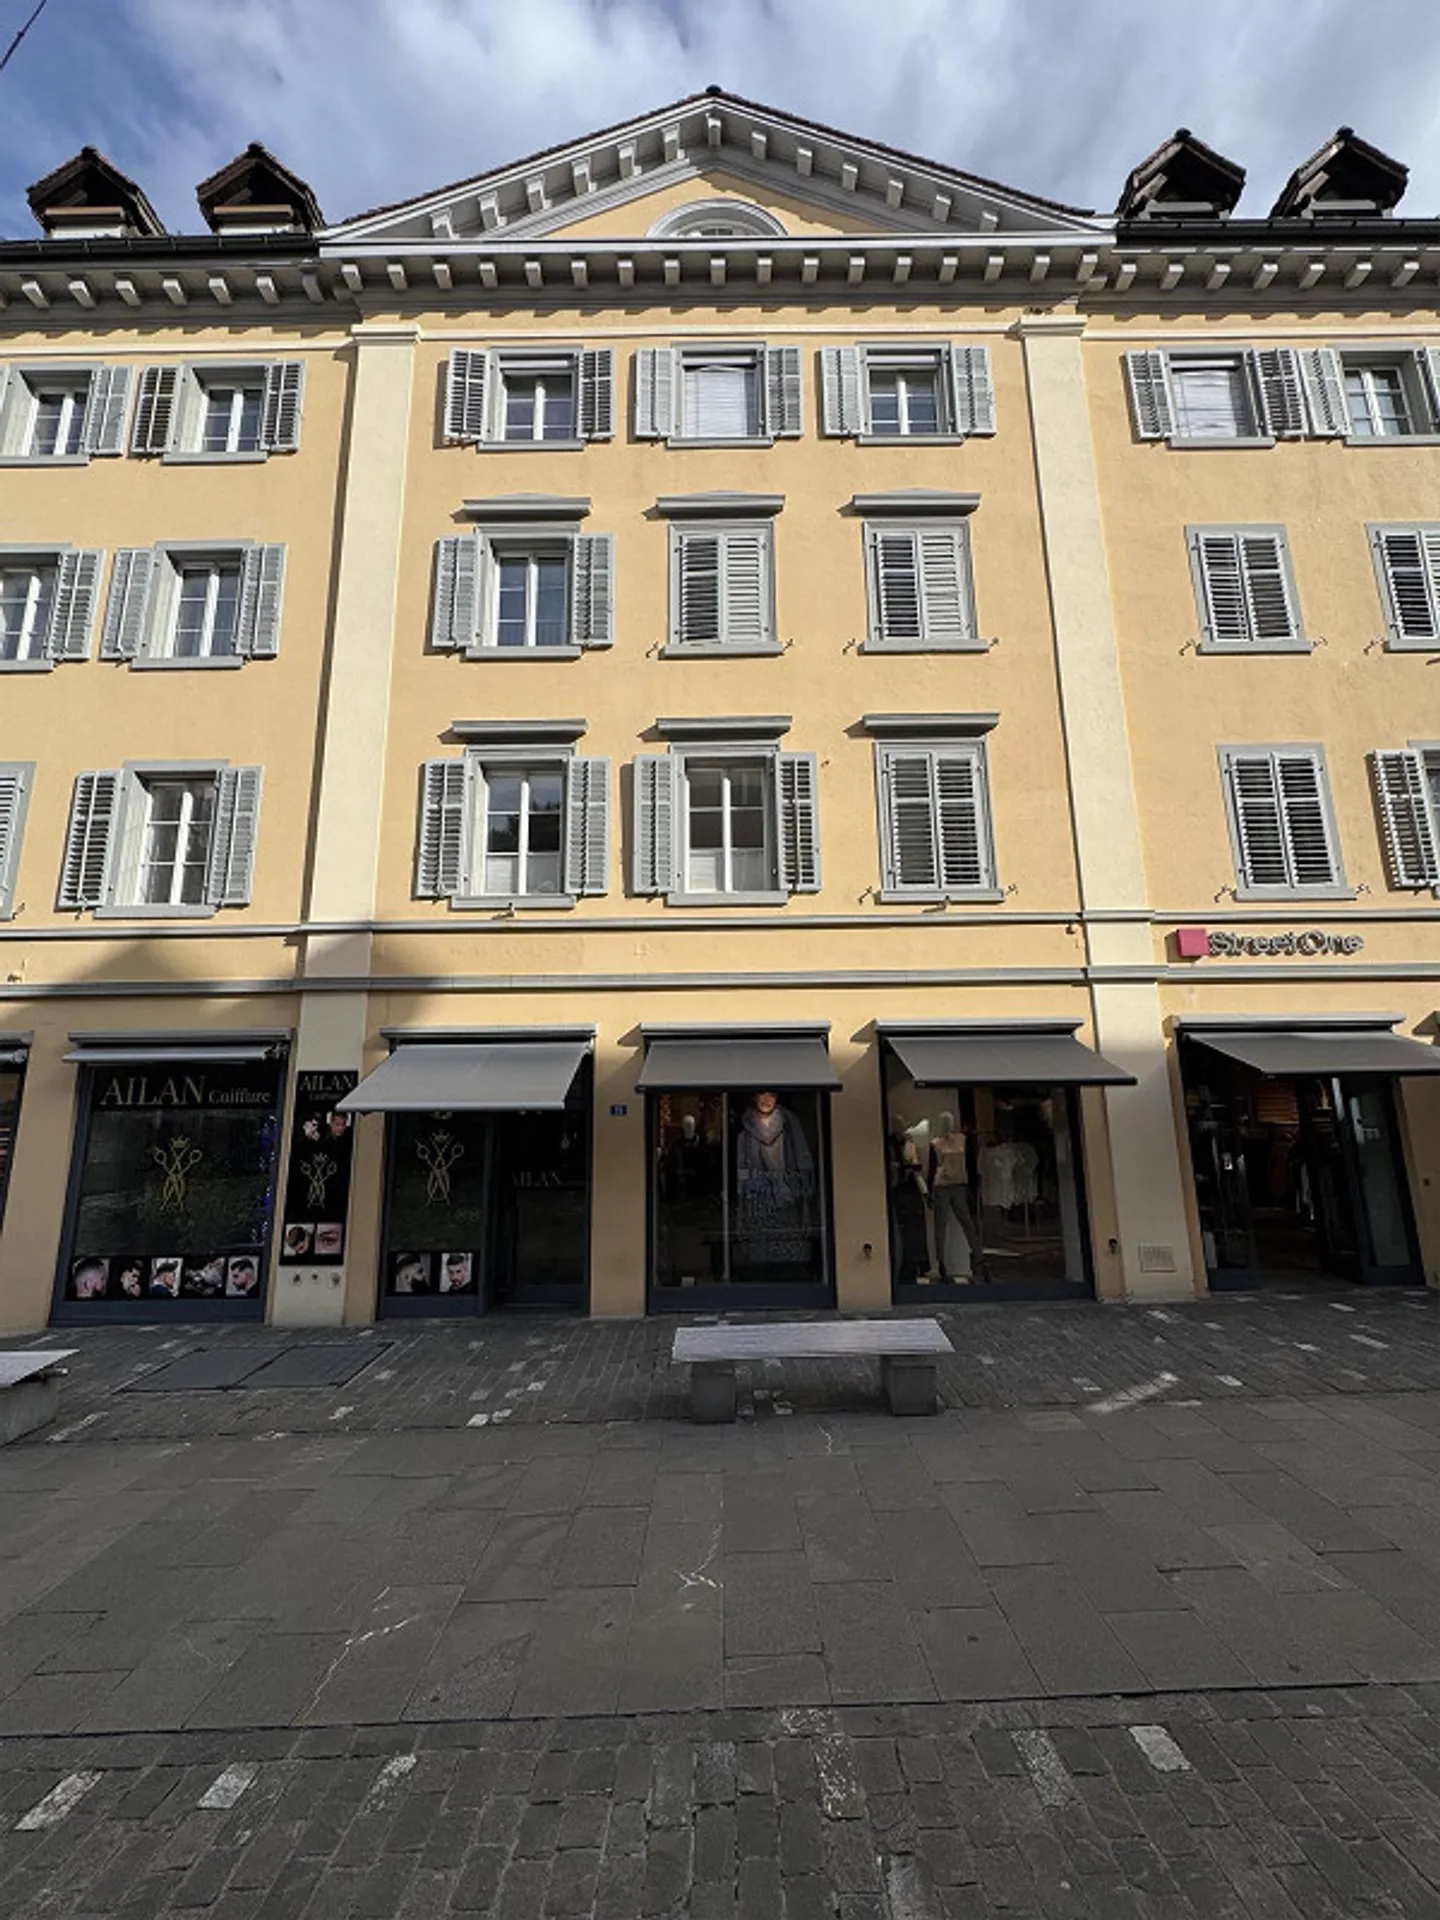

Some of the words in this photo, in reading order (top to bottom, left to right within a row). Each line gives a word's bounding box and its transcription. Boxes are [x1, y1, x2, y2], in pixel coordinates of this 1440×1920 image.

[99, 1075, 207, 1105] AILAN
[208, 1087, 272, 1104] Coiffure
[299, 1074, 356, 1092] AILAN
